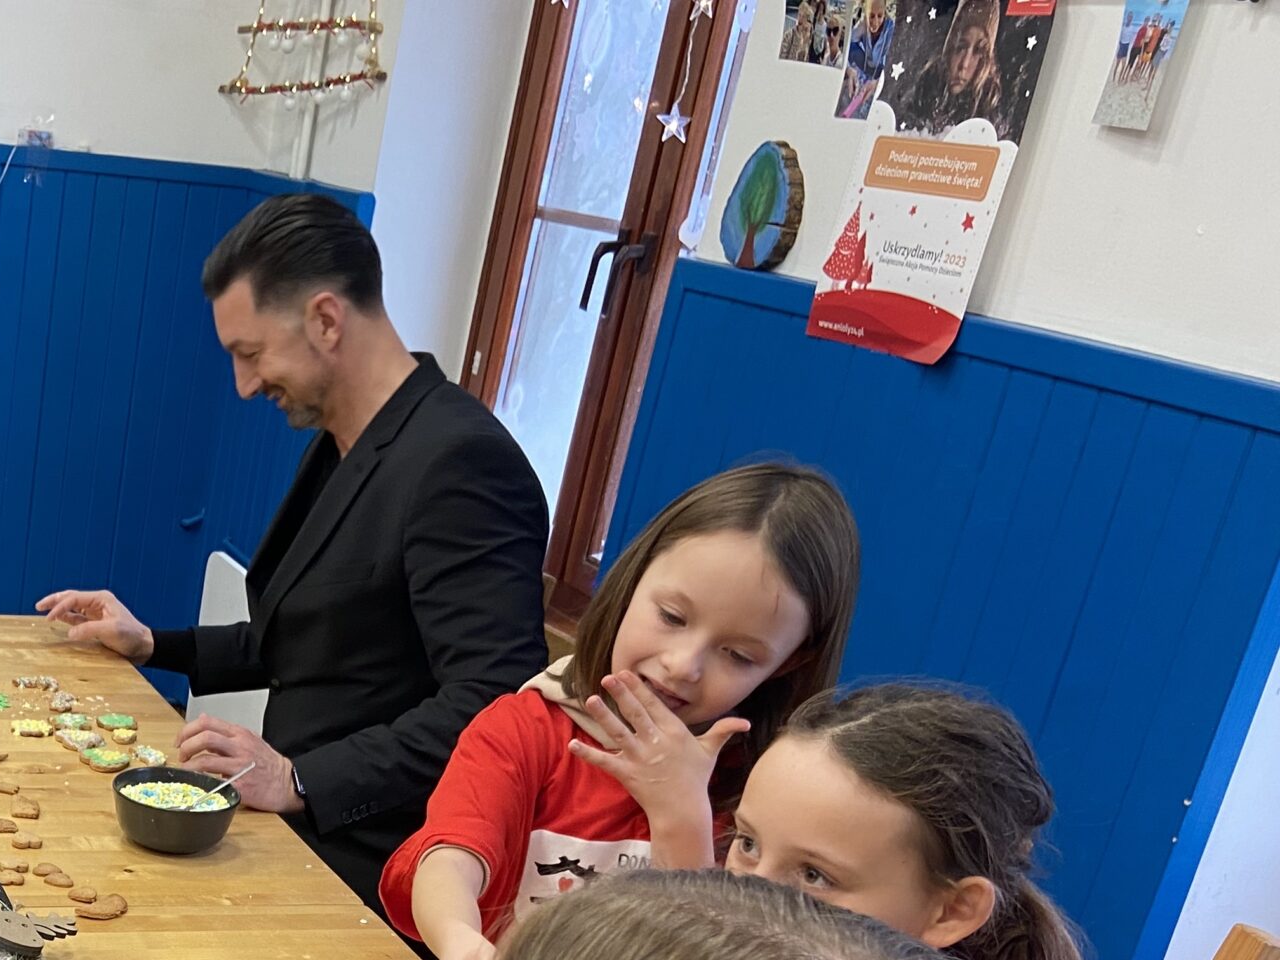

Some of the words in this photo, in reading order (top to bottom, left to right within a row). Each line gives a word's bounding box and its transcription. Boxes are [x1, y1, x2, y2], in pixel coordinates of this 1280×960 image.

[888, 150, 919, 168] Podaruj
[918, 153, 978, 174] potrzebującym
[875, 164, 910, 179] dzieciom
[908, 169, 952, 185] prawdziwe
[951, 174, 984, 190] święta!
[882, 240, 944, 265] Uskrzydlamy!
[943, 253, 967, 269] 2023
